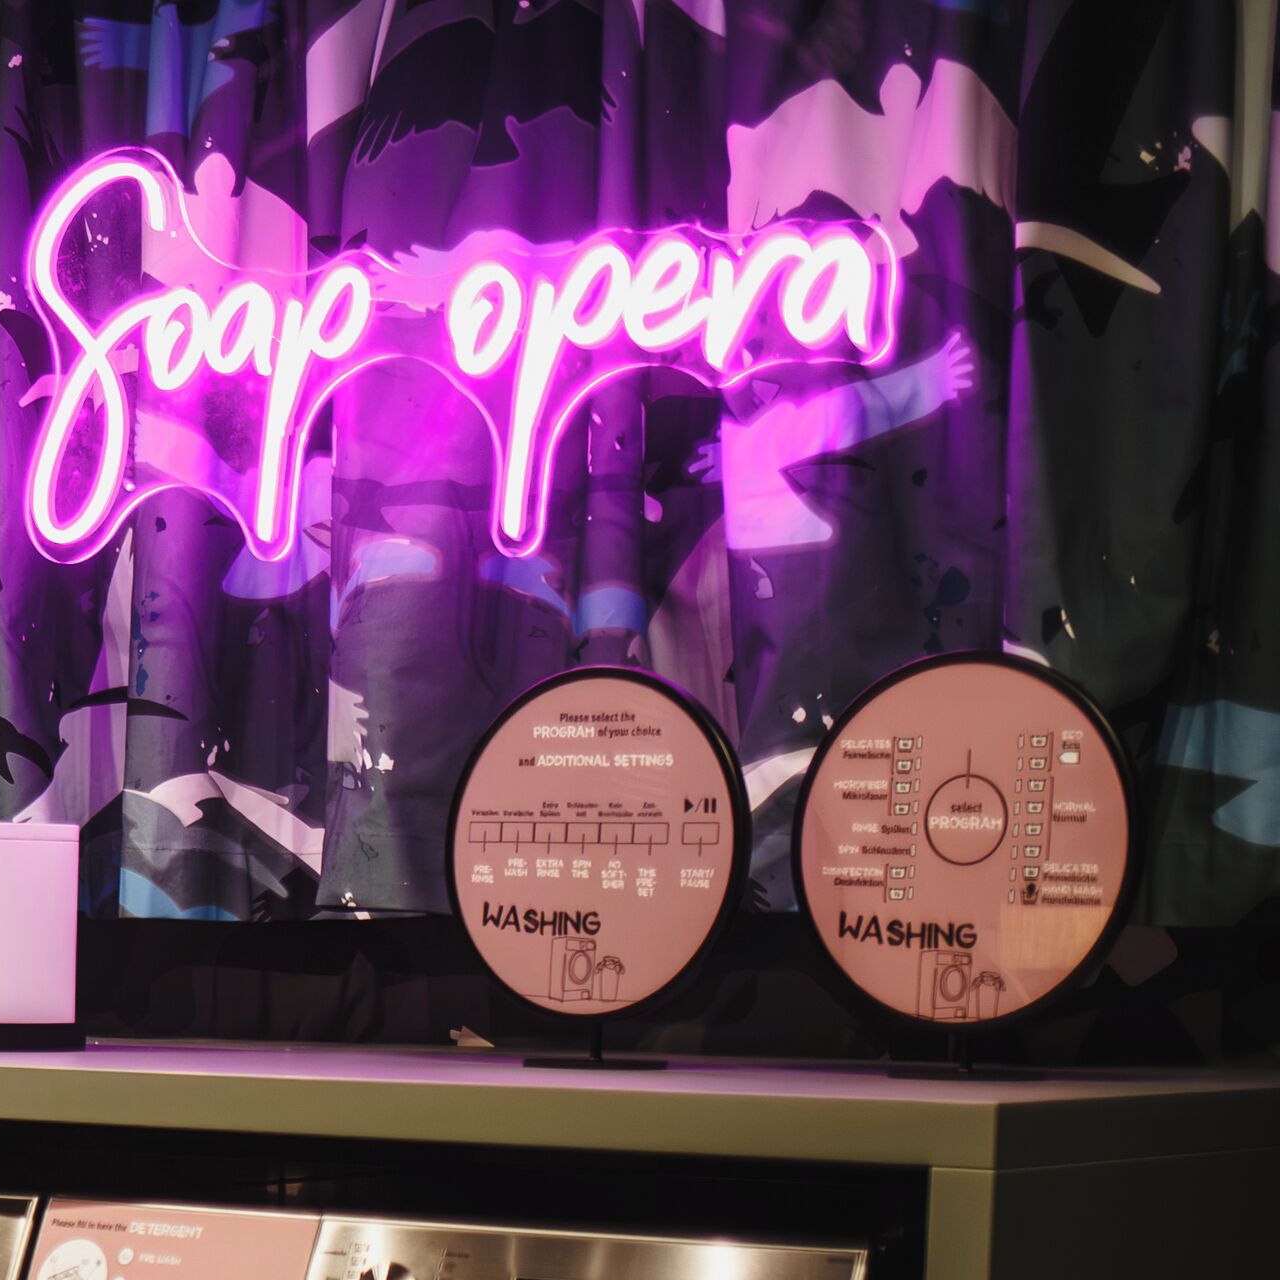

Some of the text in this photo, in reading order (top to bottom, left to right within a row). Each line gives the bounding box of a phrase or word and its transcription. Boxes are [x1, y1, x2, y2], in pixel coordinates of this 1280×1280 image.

[28, 160, 874, 546] Soap opera
[559, 711, 636, 723] Please select the
[533, 725, 595, 739] PROGRAM
[597, 727, 607, 737] of
[630, 726, 662, 738] choice
[518, 754, 674, 767] and ADDITIONAL SETTINGS
[950, 802, 983, 813] select
[929, 815, 1003, 830] PROGRAM
[482, 901, 602, 936] WASHING
[838, 910, 978, 949] WASHING
[51, 1218, 75, 1229] Please
[128, 1221, 205, 1240] DETERGENT
